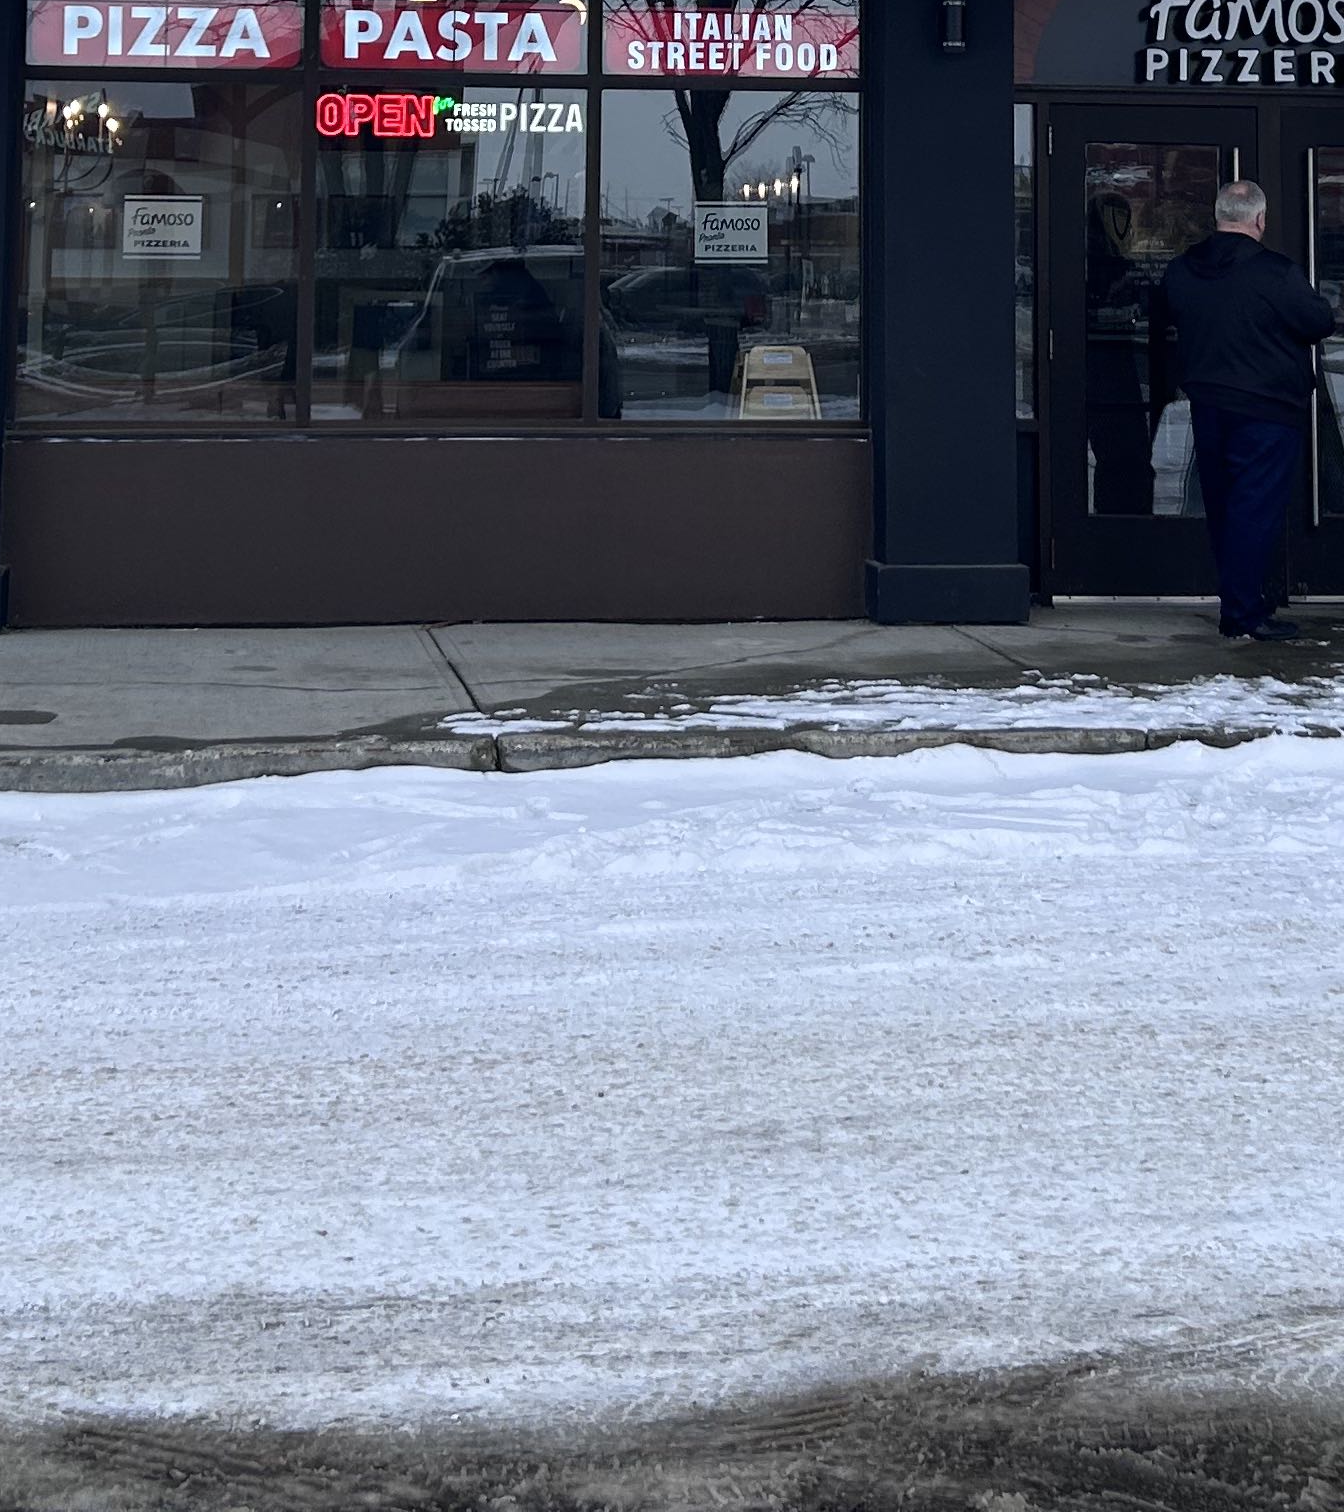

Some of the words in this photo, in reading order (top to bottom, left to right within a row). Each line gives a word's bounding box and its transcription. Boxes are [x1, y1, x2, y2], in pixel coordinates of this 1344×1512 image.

[62, 7, 271, 58] PIZZA
[344, 10, 558, 63] PASTA
[672, 12, 793, 43] ITALIAN
[627, 41, 743, 74] STREET
[756, 43, 839, 74] FOOD
[316, 93, 436, 138] OPEN
[433, 96, 455, 116] for
[453, 102, 497, 118] FRESH
[499, 102, 585, 133] PIZZA
[444, 118, 497, 133] TOSSED
[133, 239, 190, 248] PIZZERIA
[704, 244, 757, 252] PIZZERIA
